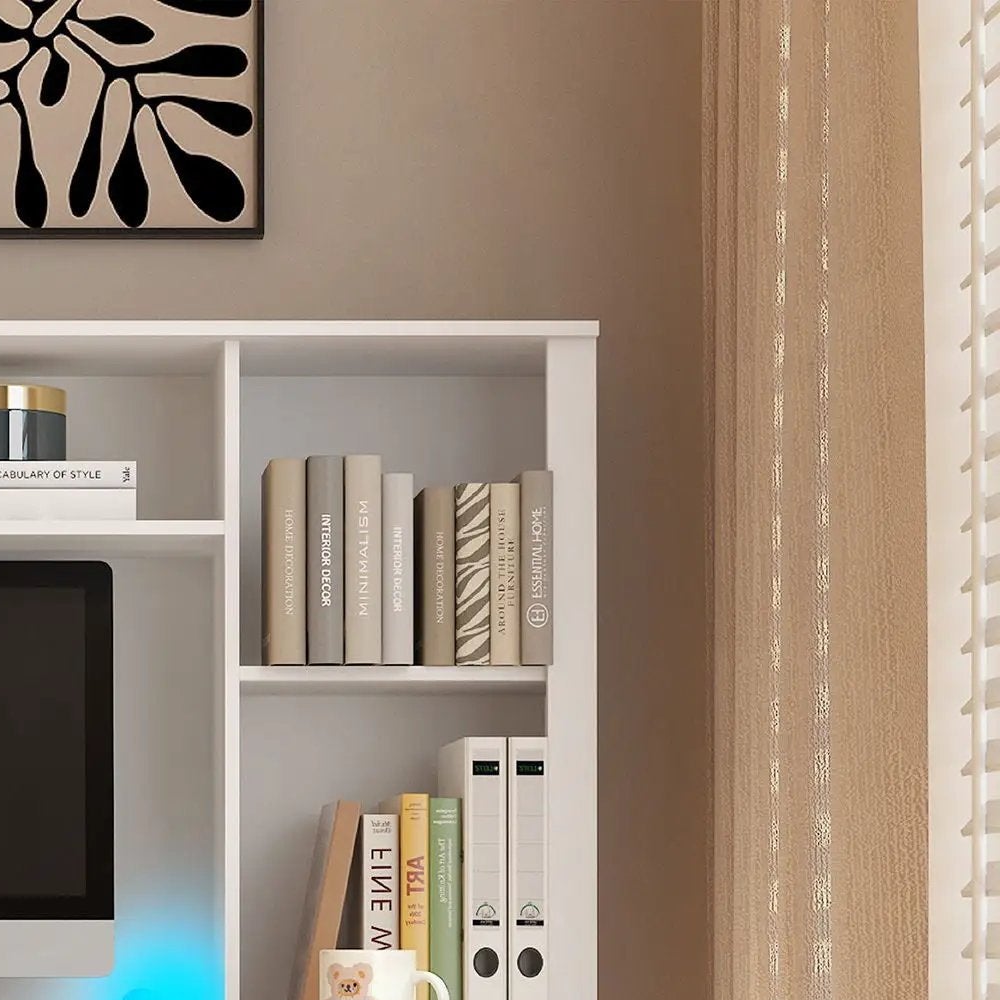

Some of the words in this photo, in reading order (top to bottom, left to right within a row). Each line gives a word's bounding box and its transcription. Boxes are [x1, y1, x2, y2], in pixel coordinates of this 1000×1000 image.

[53, 470, 67, 479] OF
[70, 470, 102, 479] STYLE
[284, 508, 295, 541] HOME
[321, 513, 332, 567] INTERIOR
[436, 531, 444, 561] HOME
[498, 508, 506, 552] HOUSE
[531, 506, 543, 542] HOME
[358, 500, 369, 617] MINIMALISM
[392, 526, 402, 573] INTERIOR
[498, 554, 506, 579] THE
[532, 543, 543, 598] ESSENTIAL
[285, 547, 296, 616] DECORATION
[321, 568, 332, 607] DECOR
[393, 574, 402, 612] DECOR
[436, 563, 444, 624] DECORATION
[497, 583, 506, 634] AROUND
